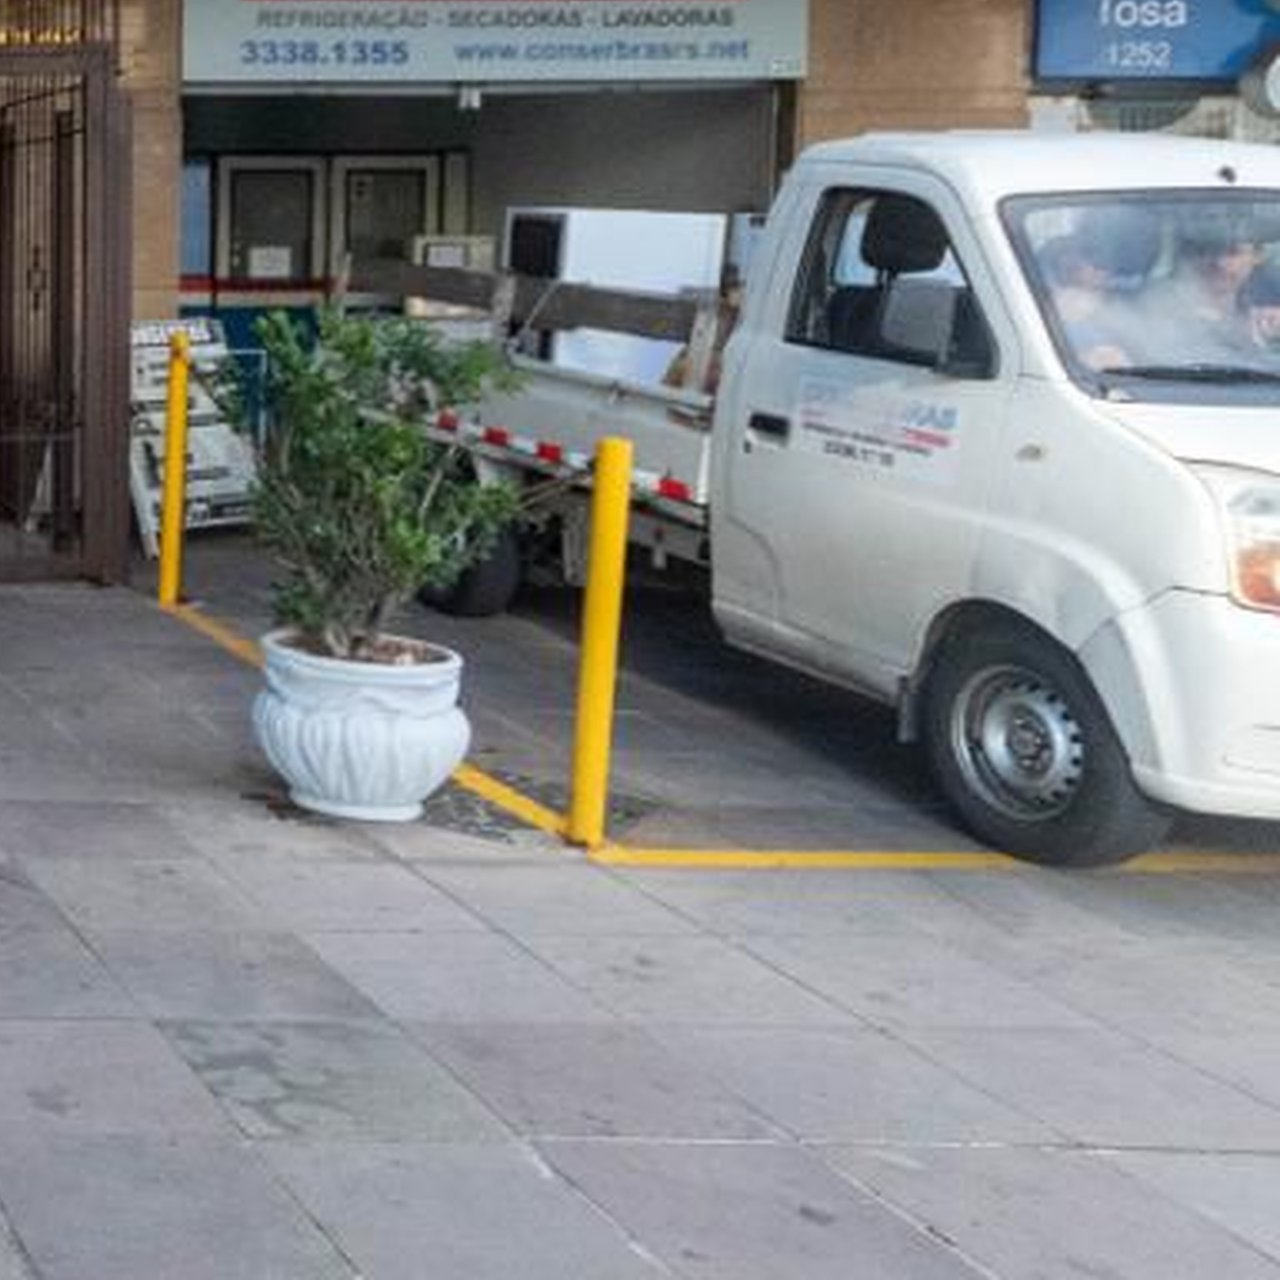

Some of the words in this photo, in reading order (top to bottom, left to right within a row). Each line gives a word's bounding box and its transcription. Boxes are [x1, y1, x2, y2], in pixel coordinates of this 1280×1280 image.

[602, 7, 733, 28] LAVADORAS
[241, 40, 409, 64] 3338.1355
[1108, 41, 1172, 68] 1252
